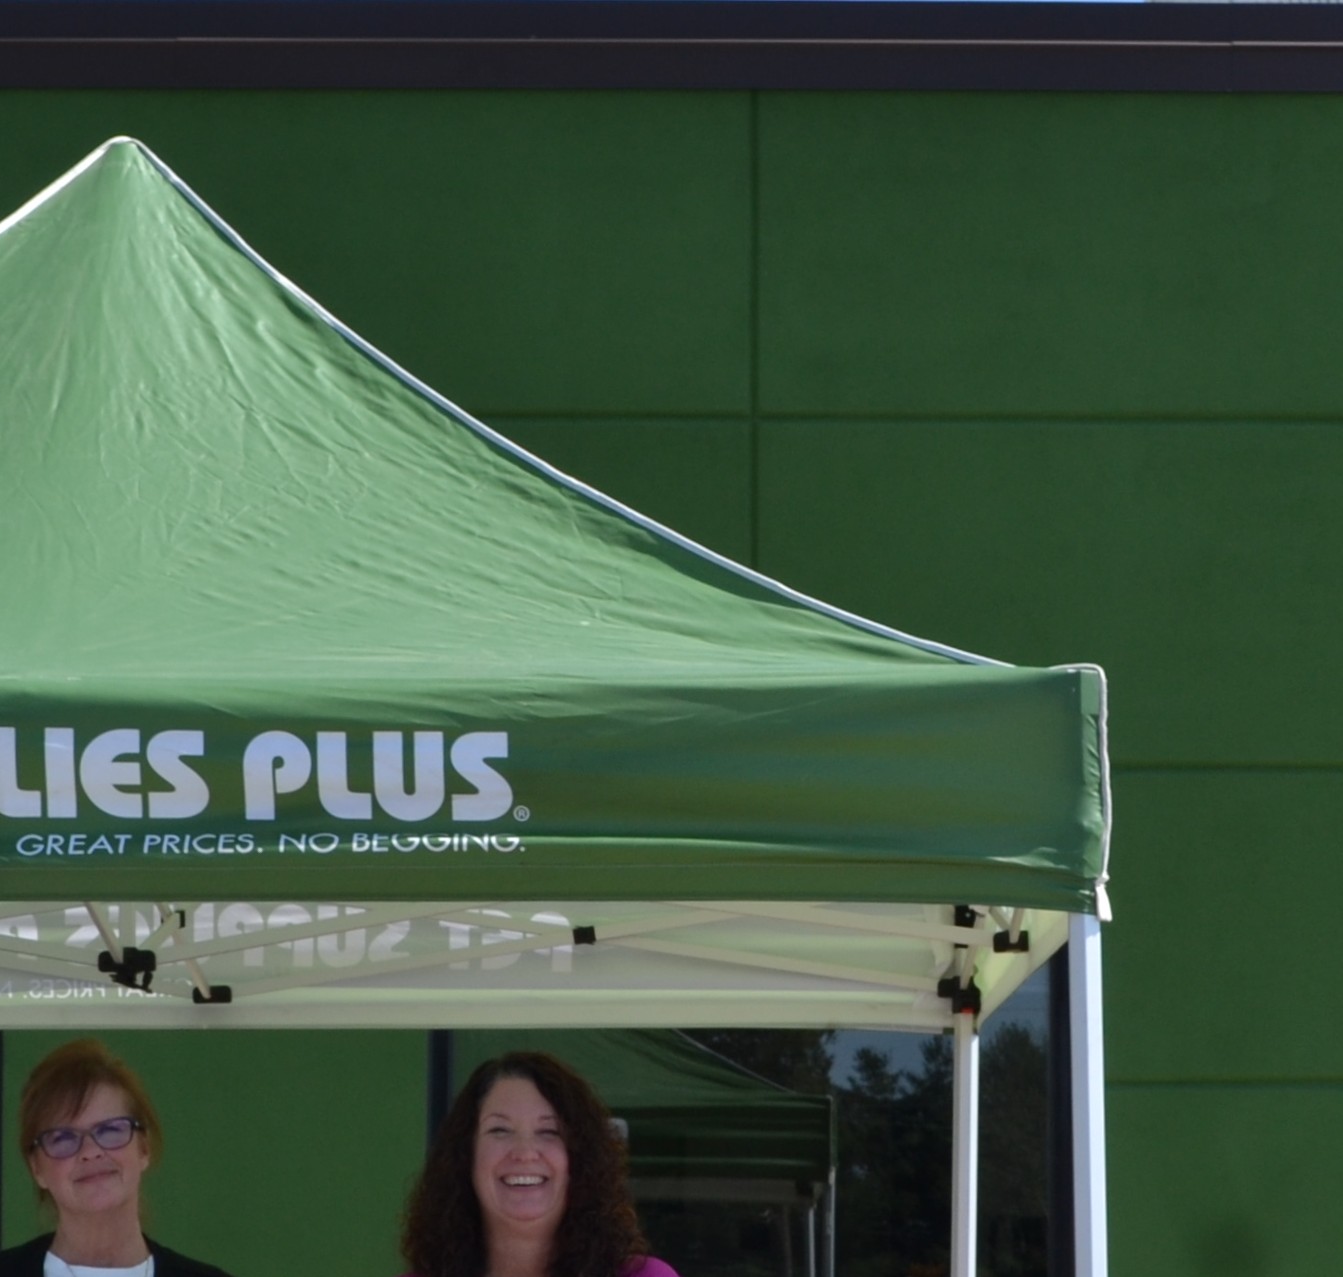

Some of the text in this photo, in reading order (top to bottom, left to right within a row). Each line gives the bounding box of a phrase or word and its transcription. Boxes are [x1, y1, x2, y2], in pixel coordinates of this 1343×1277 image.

[15, 833, 527, 857] GREAT PRICES. NO BEGGING.
